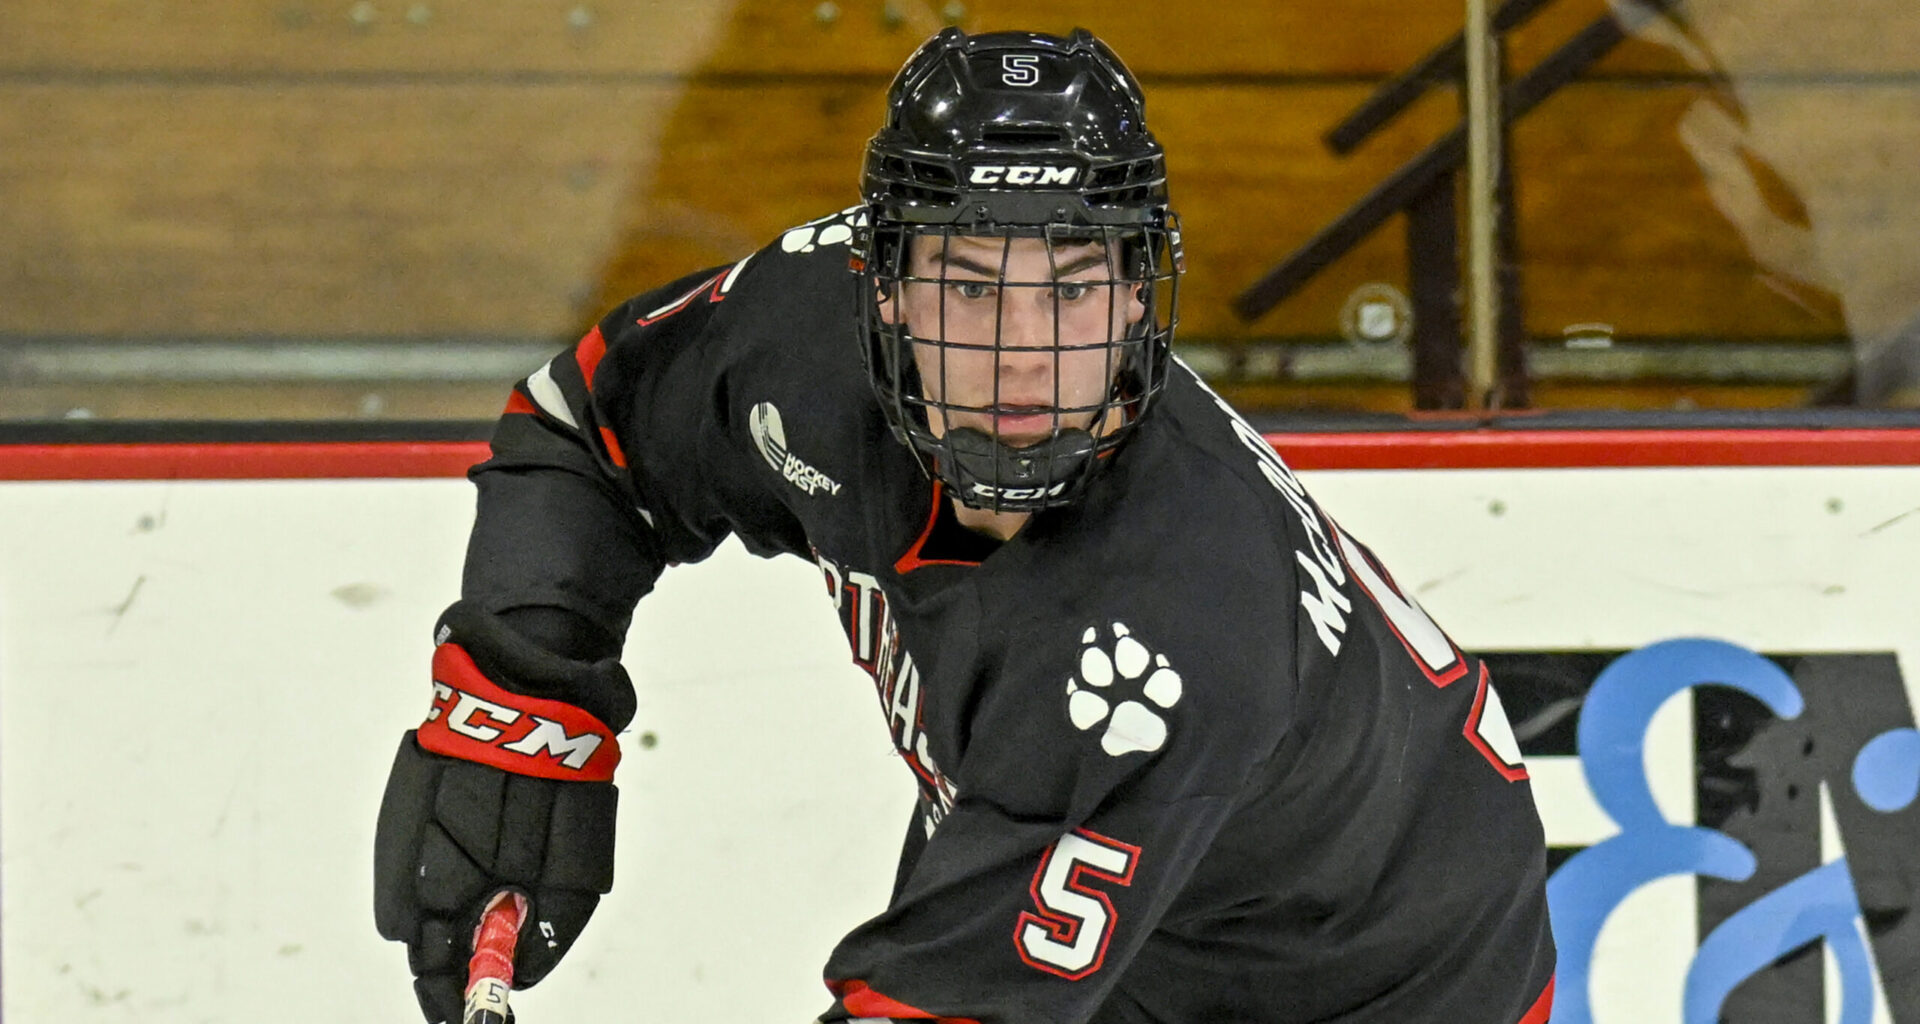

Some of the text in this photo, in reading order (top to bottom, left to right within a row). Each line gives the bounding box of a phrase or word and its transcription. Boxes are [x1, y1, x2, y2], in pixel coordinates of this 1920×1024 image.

[1002, 55, 1039, 86] 5
[969, 166, 1077, 185] CCM
[783, 462, 817, 496] EAST
[785, 452, 842, 496] HOCKEY
[428, 680, 603, 771] CCM
[1013, 826, 1142, 982] 5
[486, 982, 504, 1004] 5
